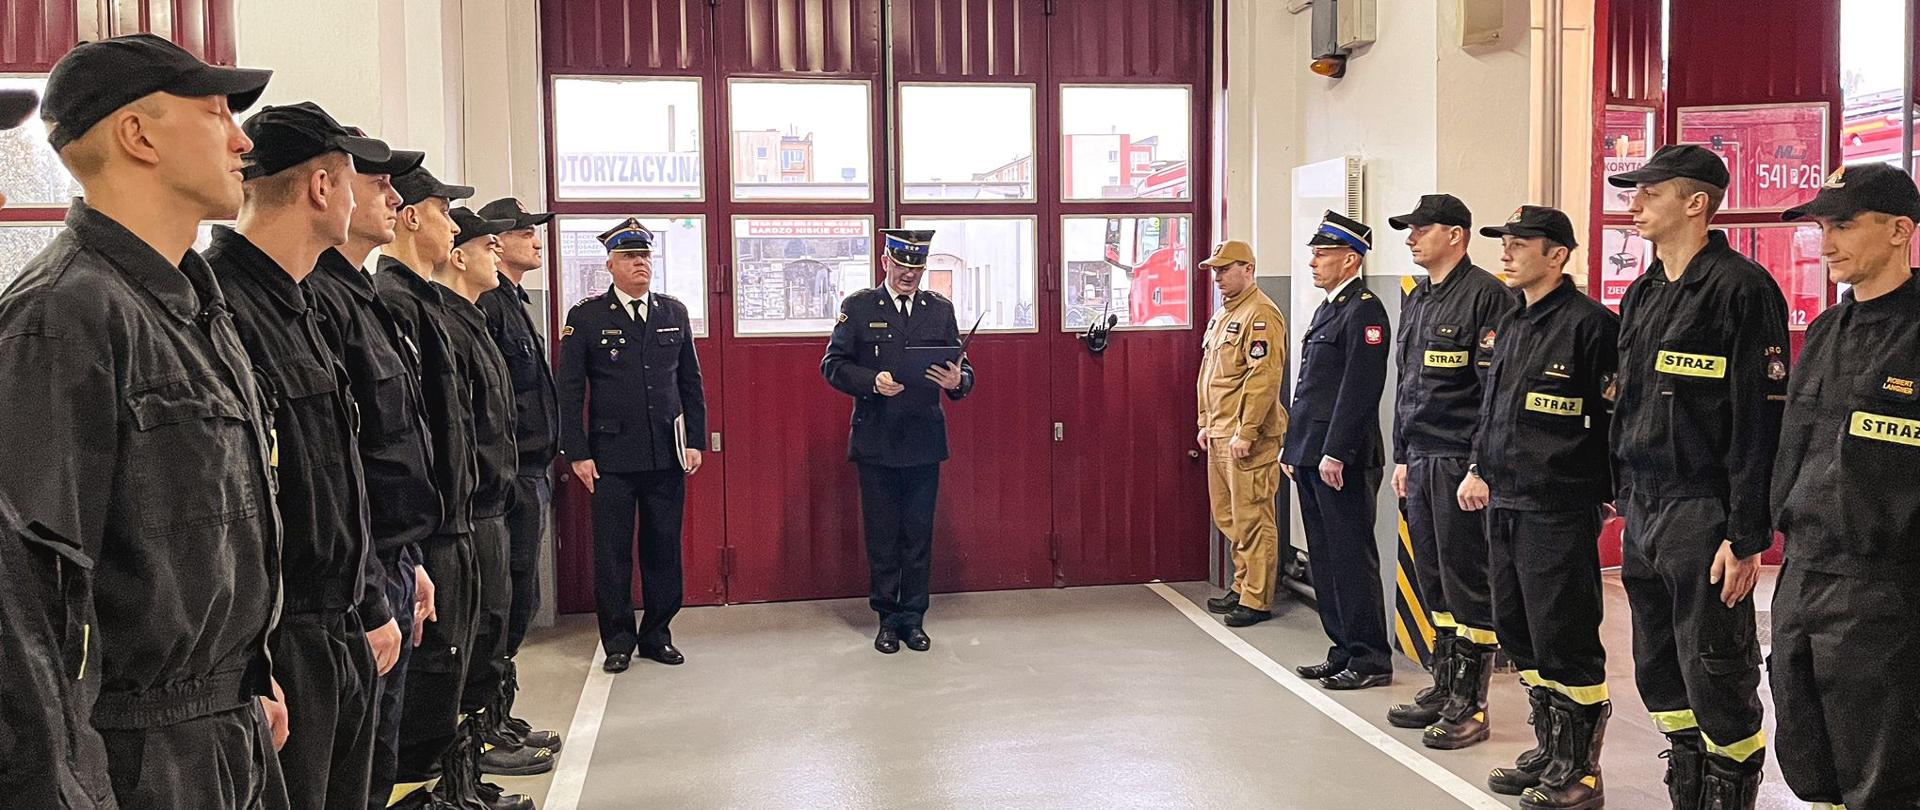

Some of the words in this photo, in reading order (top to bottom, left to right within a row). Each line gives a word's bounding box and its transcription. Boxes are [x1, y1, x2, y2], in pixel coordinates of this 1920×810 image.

[1759, 164, 1787, 189] 541
[751, 227, 793, 235] BARDZO
[796, 227, 830, 235] NISKIE
[832, 227, 862, 235] CENY
